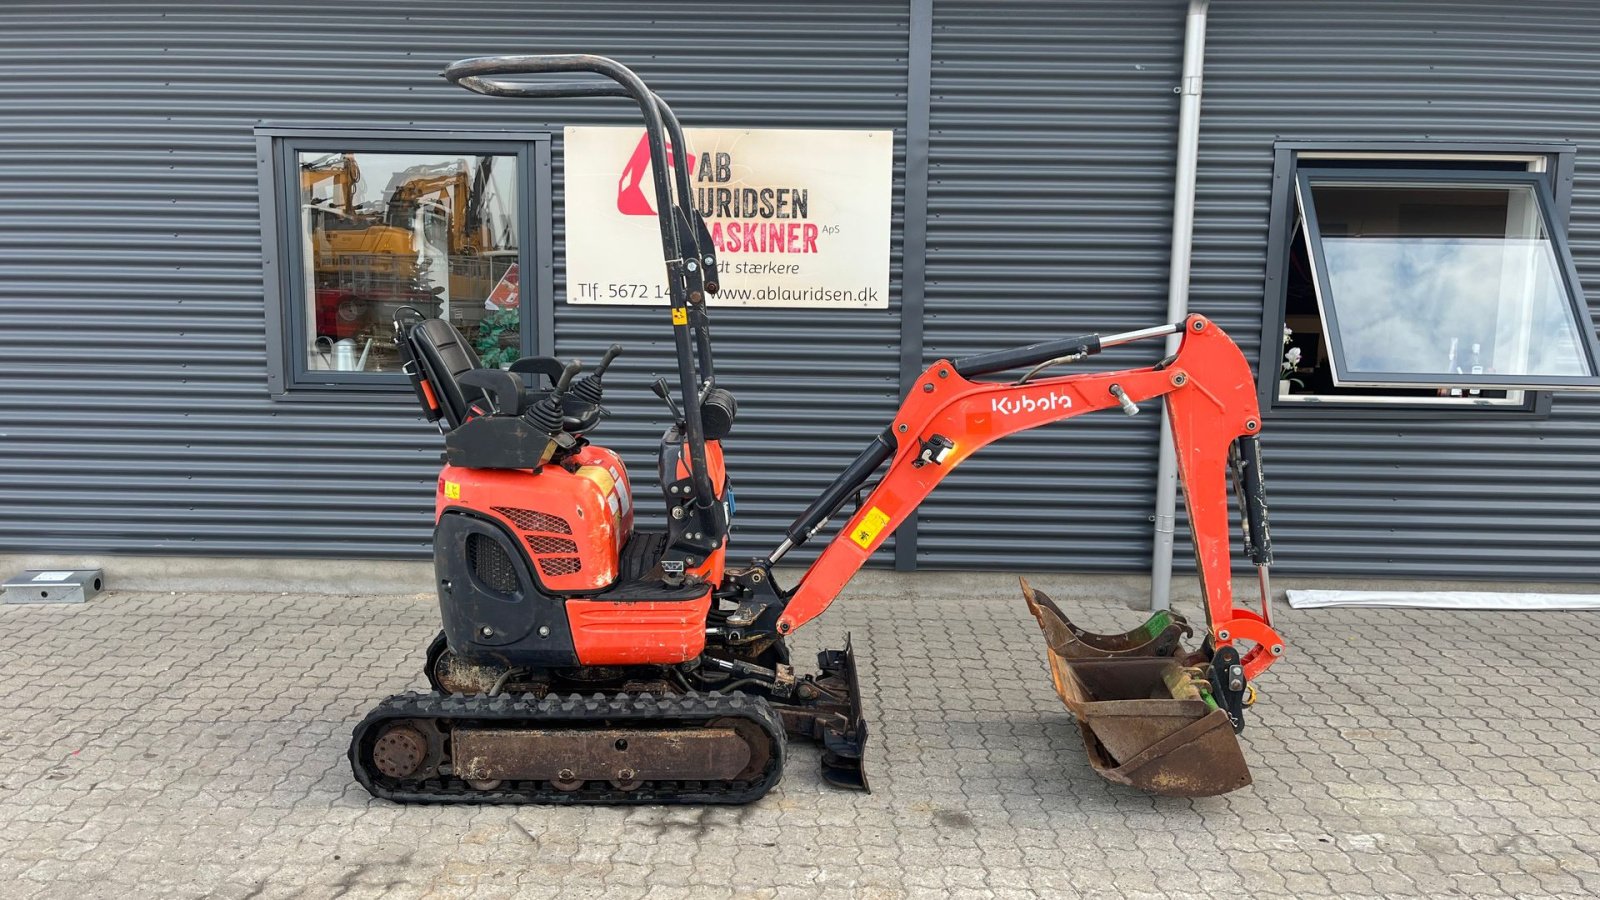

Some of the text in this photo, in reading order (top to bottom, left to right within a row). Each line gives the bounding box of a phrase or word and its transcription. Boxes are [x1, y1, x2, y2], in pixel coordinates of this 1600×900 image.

[697, 151, 732, 183] AB
[698, 187, 808, 219] URIDSEN
[711, 221, 841, 254] ASKINER ApS
[735, 260, 800, 275] stærkere
[577, 282, 603, 301] Tlf.
[608, 283, 649, 299] 5672
[991, 391, 1073, 415] Kubota
